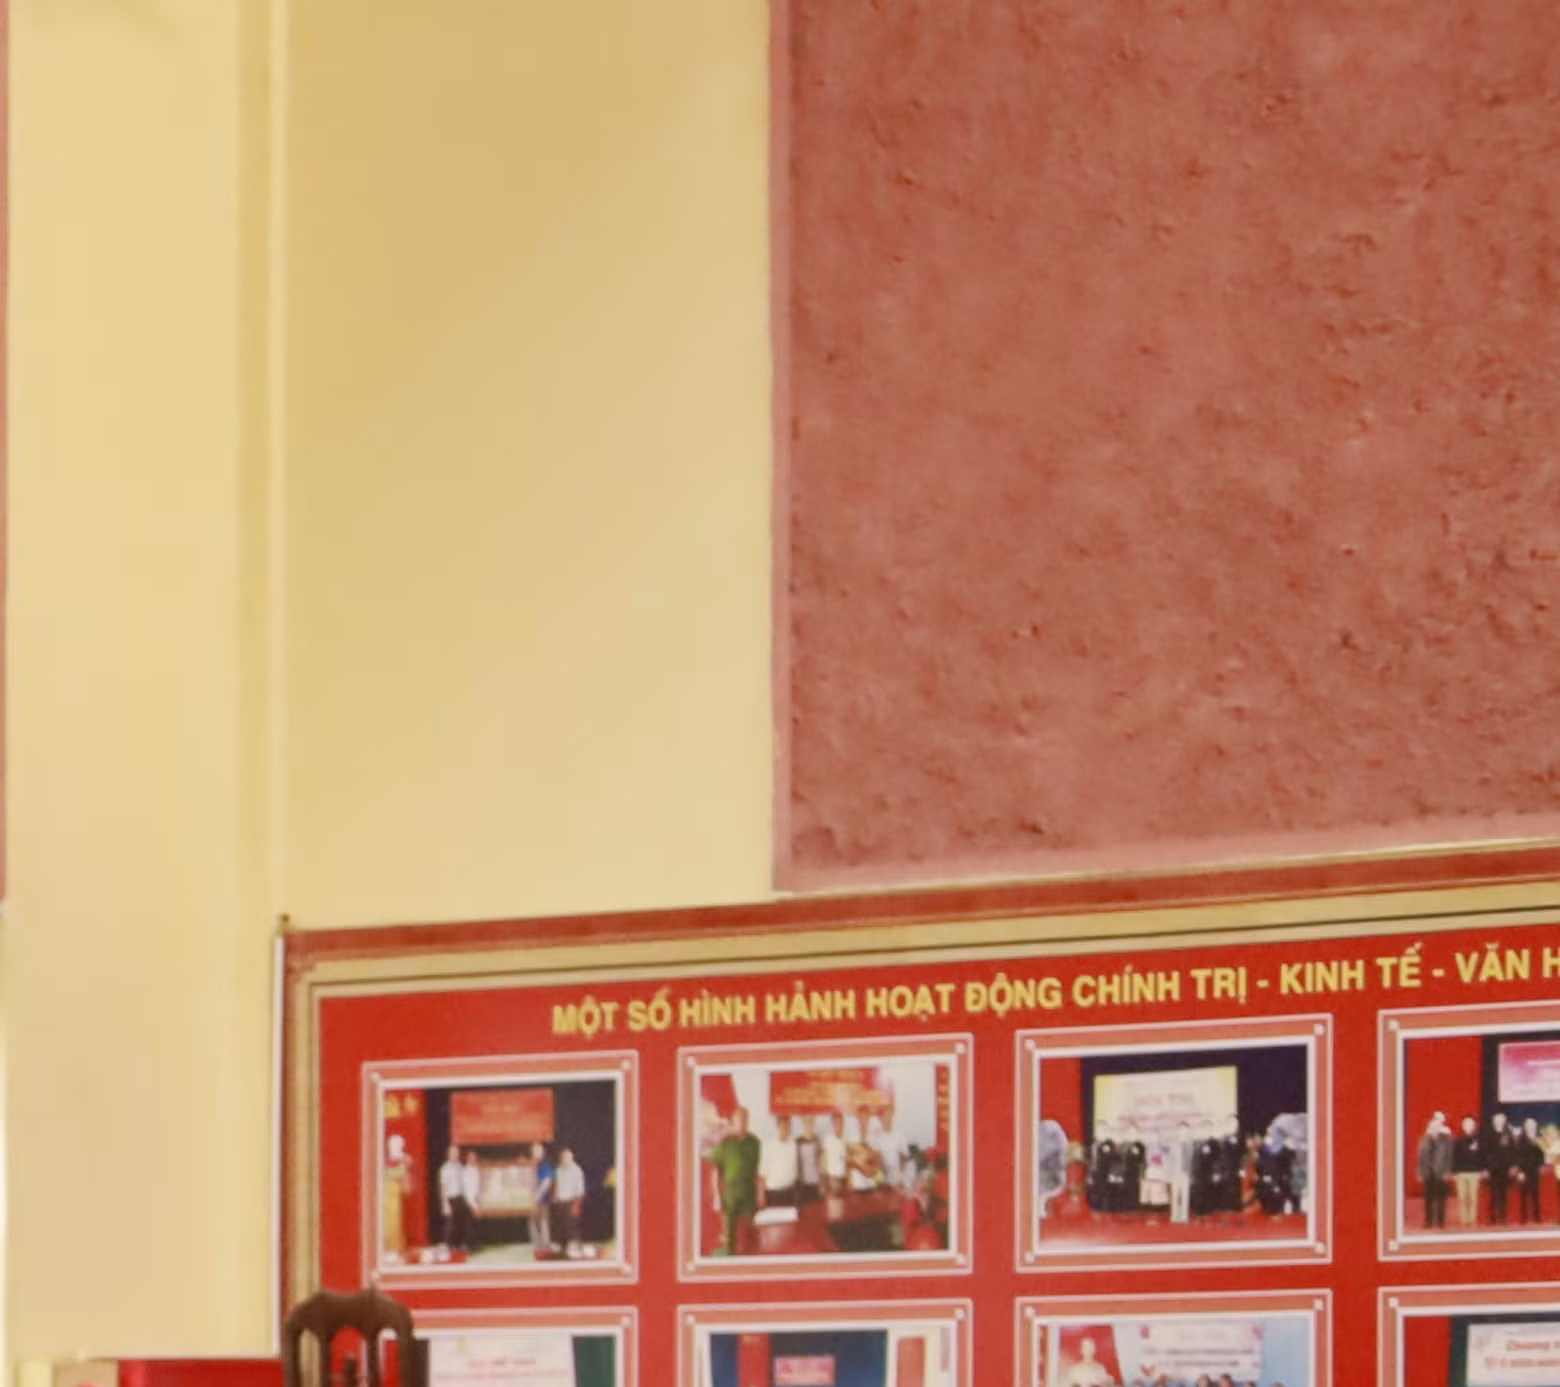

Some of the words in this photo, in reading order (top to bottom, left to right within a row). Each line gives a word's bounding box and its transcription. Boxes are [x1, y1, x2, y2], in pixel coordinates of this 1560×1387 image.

[553, 995, 618, 1039] MỘT
[627, 986, 672, 1032] SỐ
[678, 990, 756, 1027] HÌNH
[765, 980, 856, 1022] HẢNH
[865, 983, 955, 1022] HOẠT
[962, 972, 1063, 1018] ĐỘNG
[1071, 965, 1180, 1006] CHÍNH
[1190, 966, 1248, 1004] TRỊ
[1279, 959, 1365, 995] KINH
[1375, 940, 1422, 989] TẾ
[1454, 941, 1531, 983] VĂN
